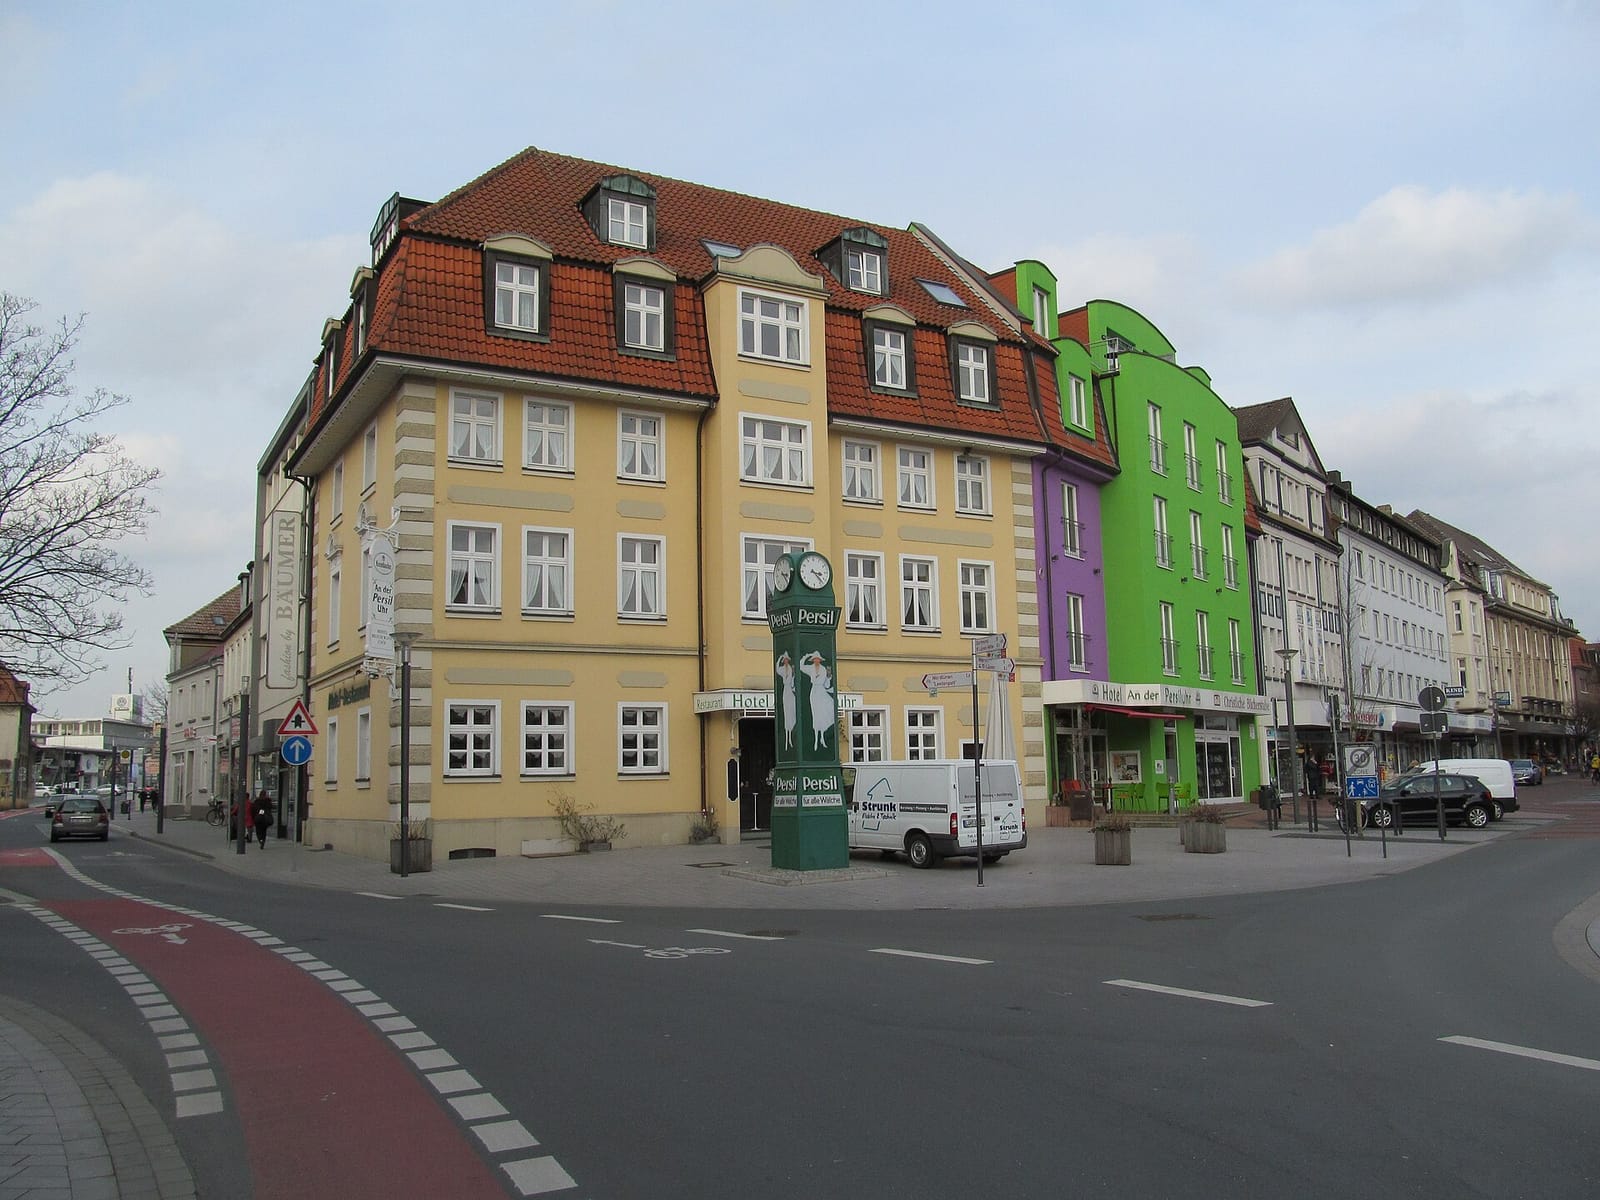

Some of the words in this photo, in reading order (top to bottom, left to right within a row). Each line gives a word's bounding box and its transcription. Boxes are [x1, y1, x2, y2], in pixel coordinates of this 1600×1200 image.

[276, 516, 296, 620] BÄUMER
[374, 584, 382, 592] An
[383, 586, 392, 594] der
[372, 593, 393, 605] Persil
[377, 605, 389, 614] Uhr
[798, 608, 834, 625] Persil
[770, 609, 793, 628] Persil
[280, 628, 295, 643] by
[280, 643, 294, 682] fashion
[733, 694, 769, 708] Hotel
[1102, 684, 1122, 702] Hotel
[1127, 690, 1141, 700] An
[1143, 689, 1159, 700] der
[1164, 687, 1192, 705] Persiluhr
[1354, 753, 1367, 764] 30
[776, 776, 797, 791] Persil
[802, 775, 838, 791] Persil
[862, 801, 897, 812] Strunk
